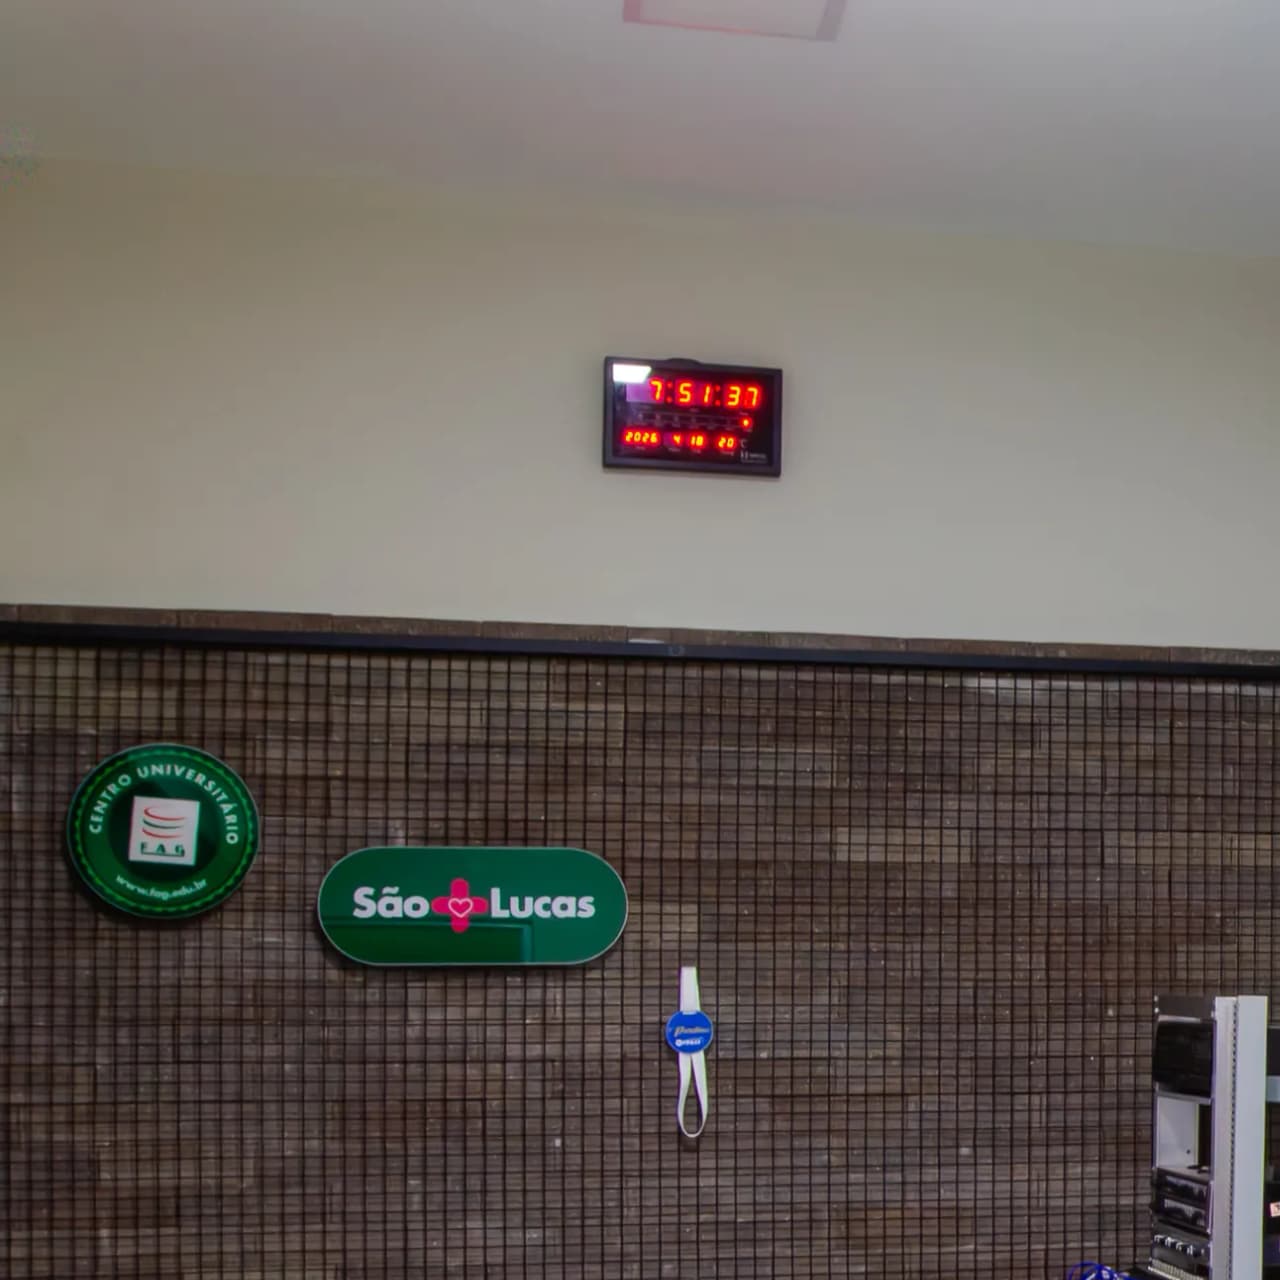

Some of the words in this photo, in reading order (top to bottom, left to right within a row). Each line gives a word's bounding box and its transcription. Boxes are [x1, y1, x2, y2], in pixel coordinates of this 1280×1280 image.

[624, 430, 659, 444] 2026
[672, 434, 682, 445] 4
[690, 435, 704, 446] 18
[717, 436, 735, 449] 20
[89, 774, 132, 834] CENTRO
[136, 763, 239, 845] UNIVERSITÁRIO
[353, 886, 430, 918] São
[490, 887, 596, 919] Lucas
